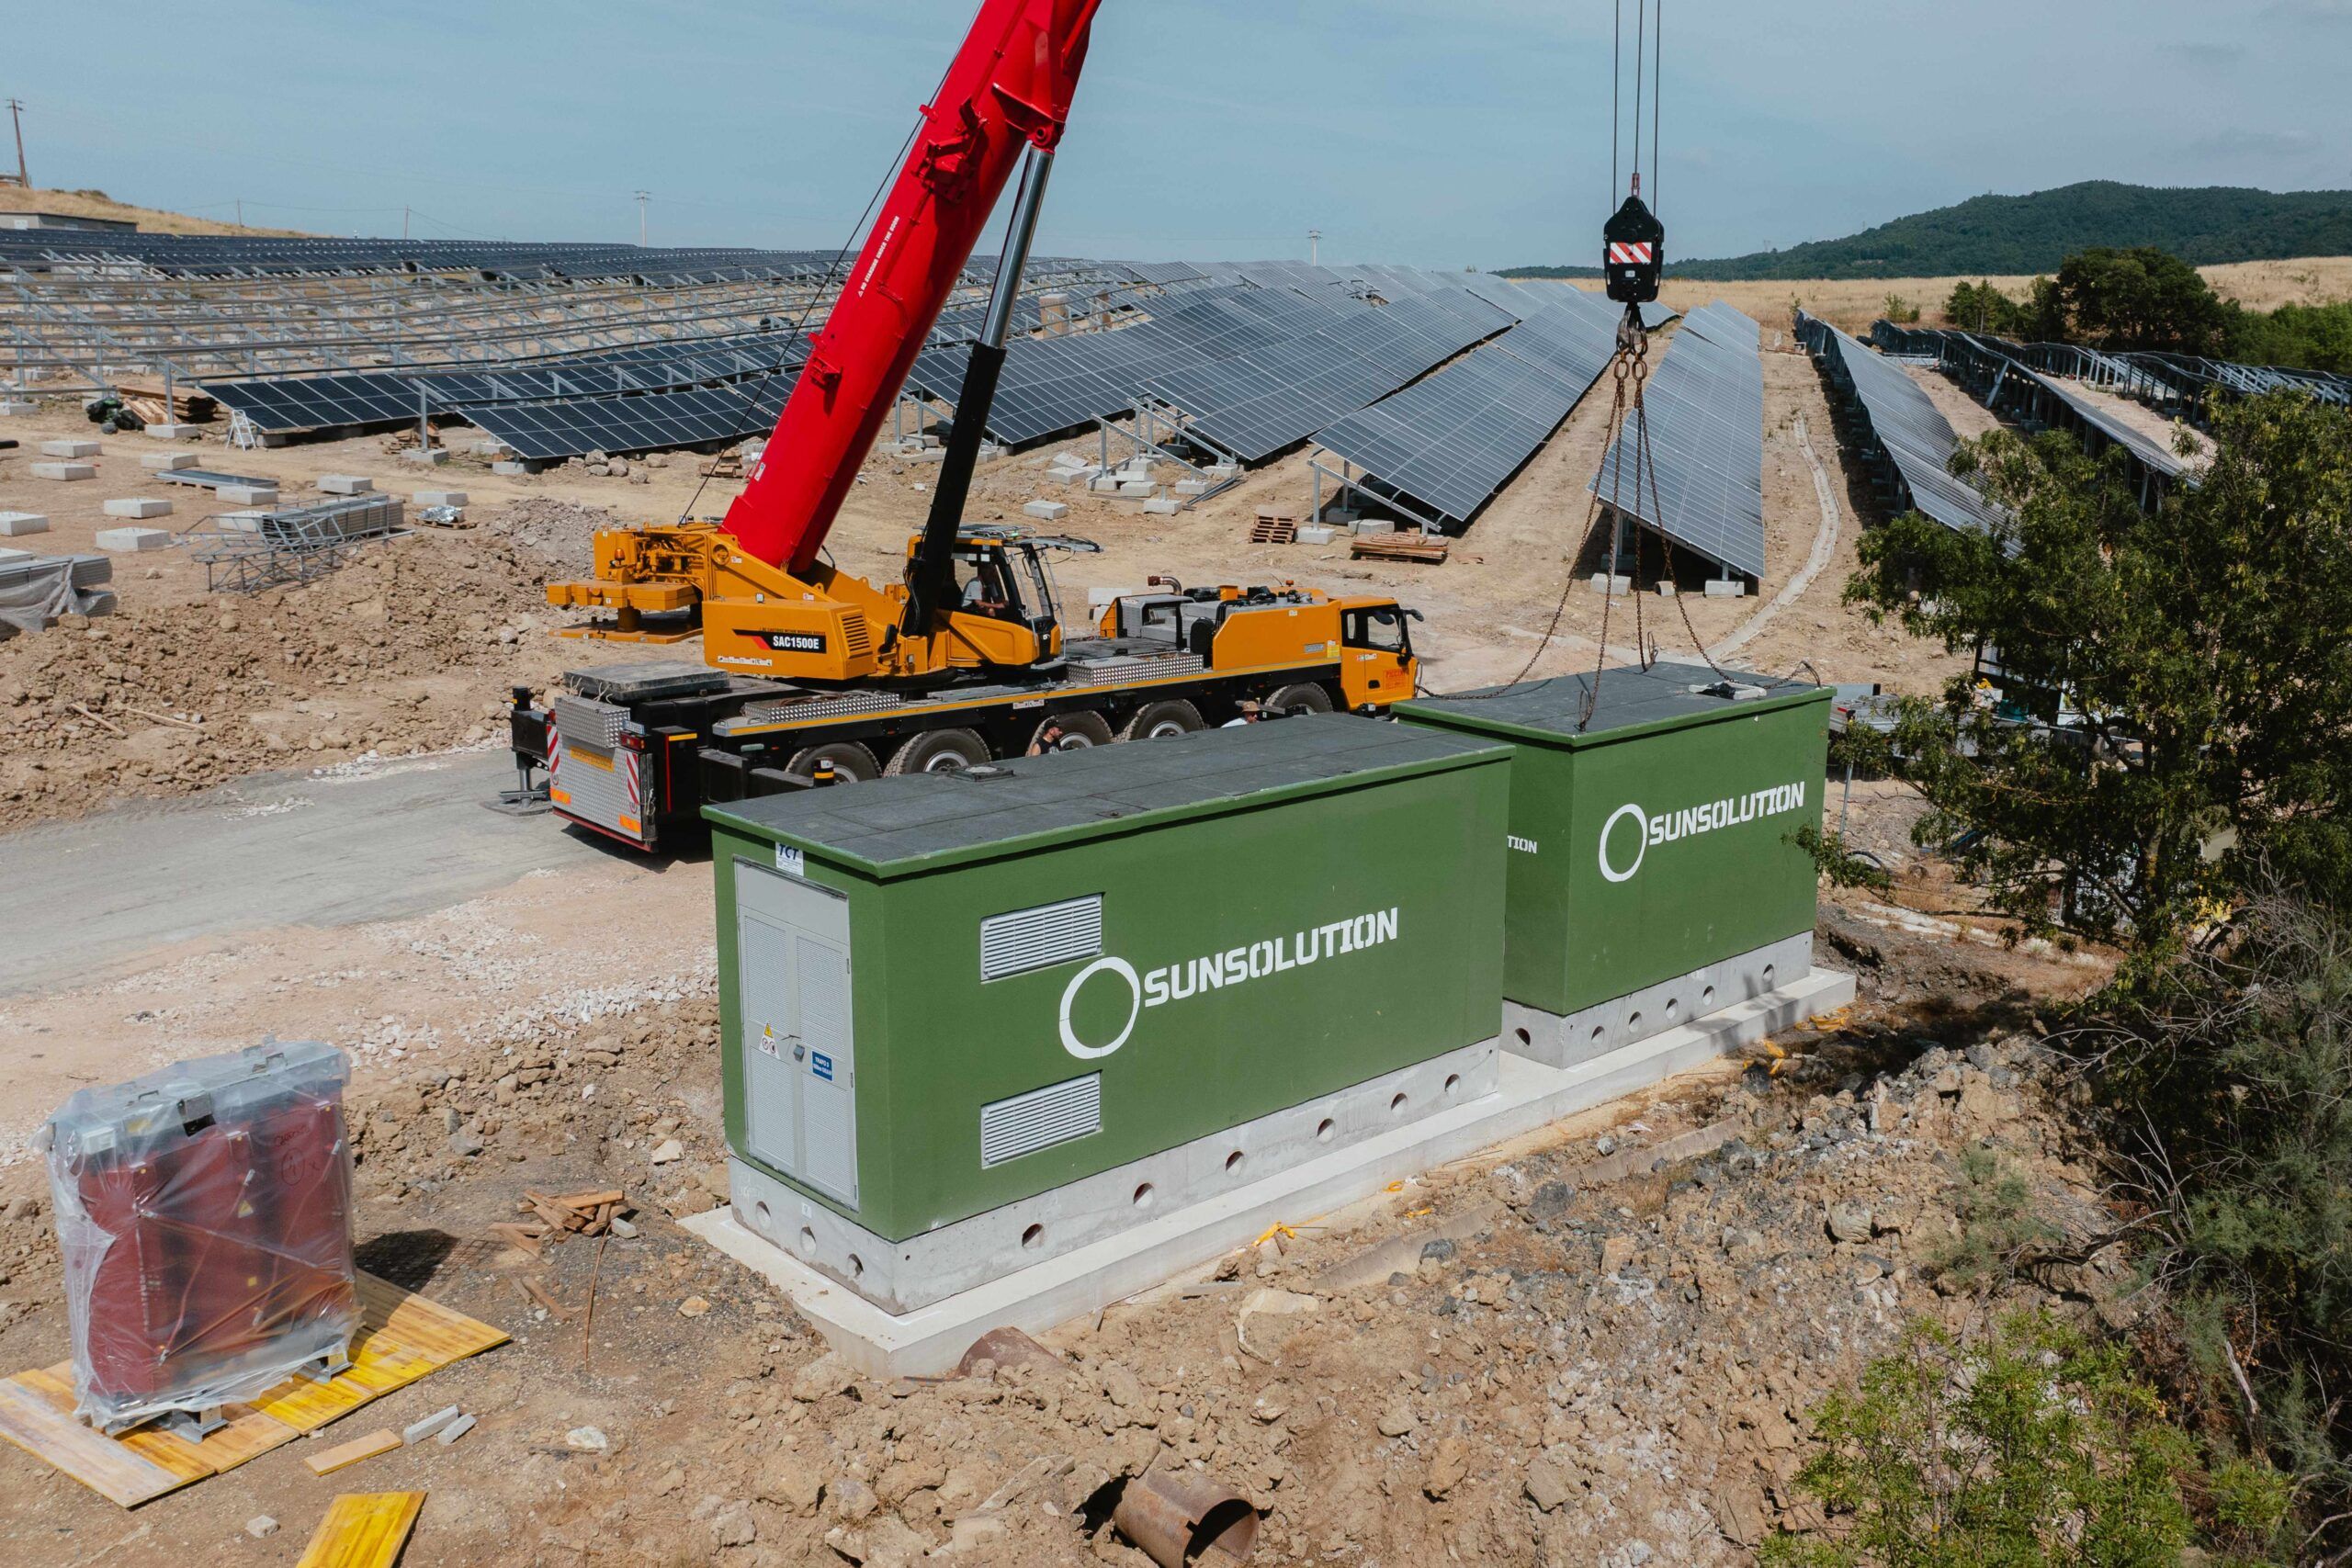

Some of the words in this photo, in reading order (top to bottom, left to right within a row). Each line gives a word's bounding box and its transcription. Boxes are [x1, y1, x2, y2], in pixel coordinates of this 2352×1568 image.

[860, 282, 867, 291] NO
[876, 242, 888, 259] UNDER
[884, 231, 893, 242] THE
[773, 636, 820, 649] SAC1500E
[1649, 781, 1805, 845] SUNSOLUTION
[779, 843, 799, 861] TCT
[1144, 907, 1398, 1008] SUNSOLUTION
